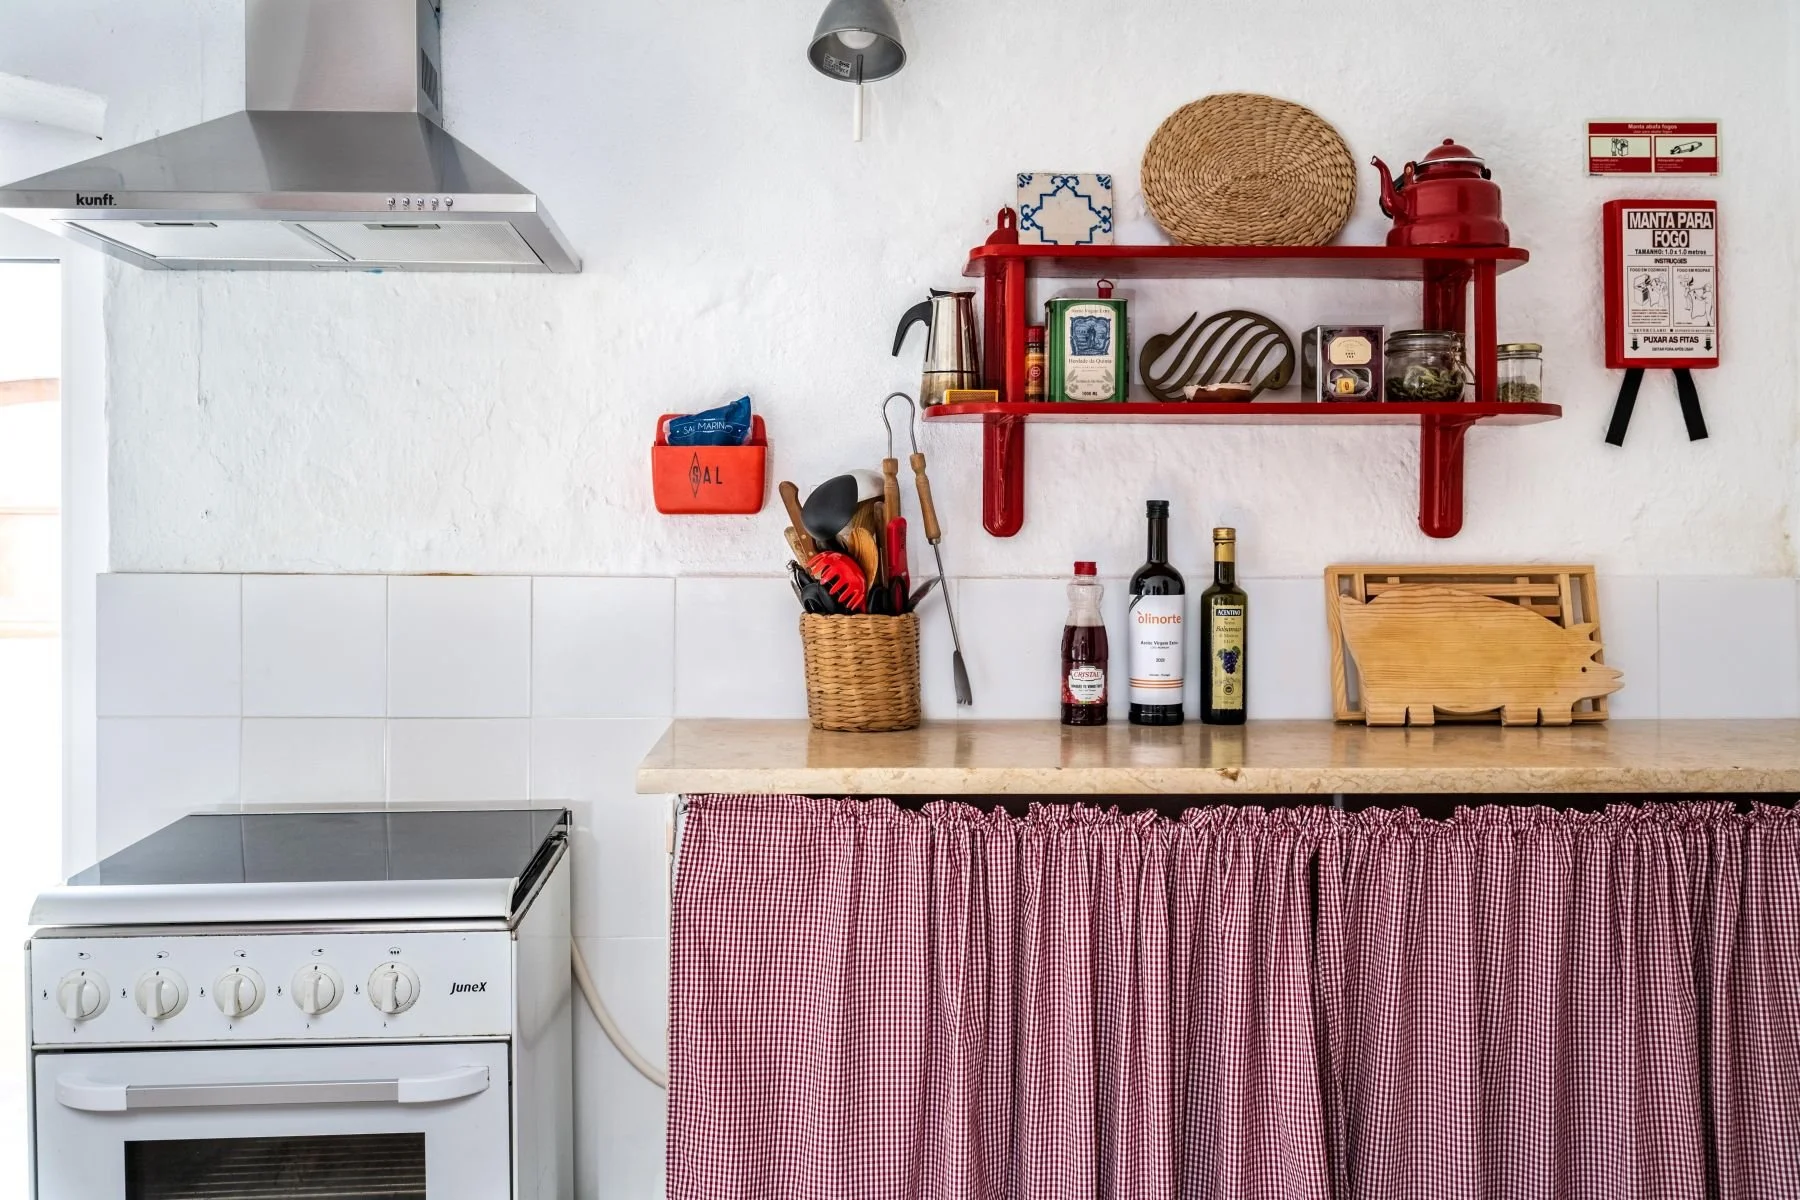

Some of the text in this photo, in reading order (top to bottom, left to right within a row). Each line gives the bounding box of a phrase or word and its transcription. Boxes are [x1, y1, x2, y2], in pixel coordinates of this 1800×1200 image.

[1629, 212, 1712, 229] MANTA PARA
[1654, 230, 1688, 248] FOGO
[692, 465, 723, 484] SAL
[449, 981, 487, 995] JuneX
